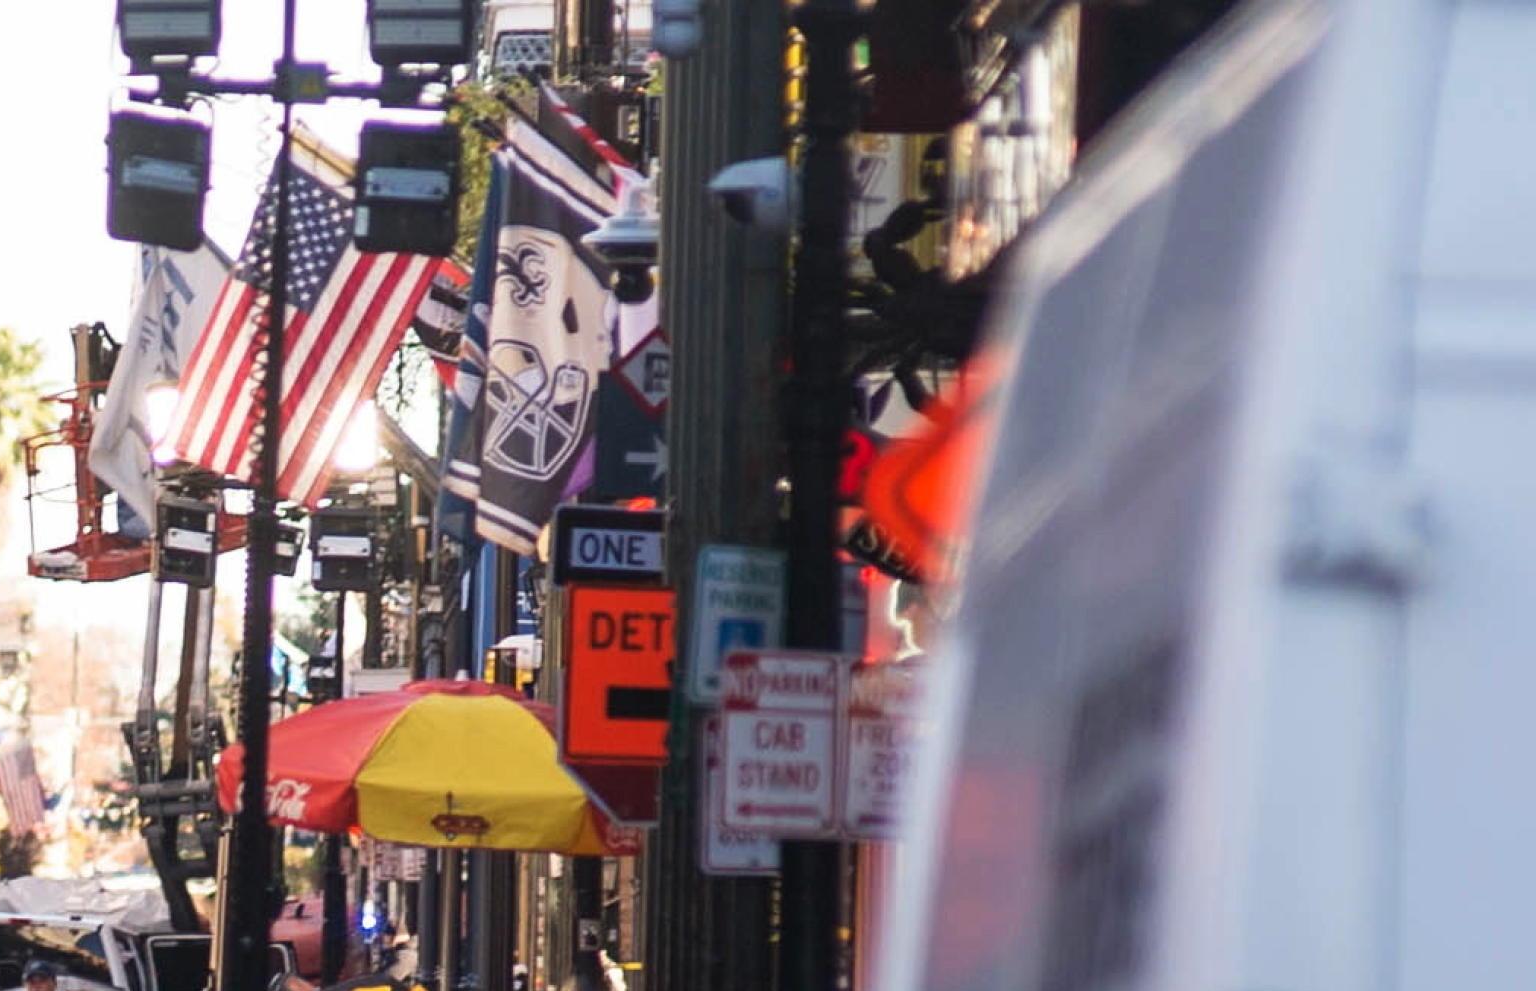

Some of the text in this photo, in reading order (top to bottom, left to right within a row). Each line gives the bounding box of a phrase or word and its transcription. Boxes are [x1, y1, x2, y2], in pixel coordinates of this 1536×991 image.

[578, 532, 646, 566] ONE
[588, 610, 672, 653] DET
[754, 720, 808, 752] CAB
[736, 762, 822, 793] STAND
